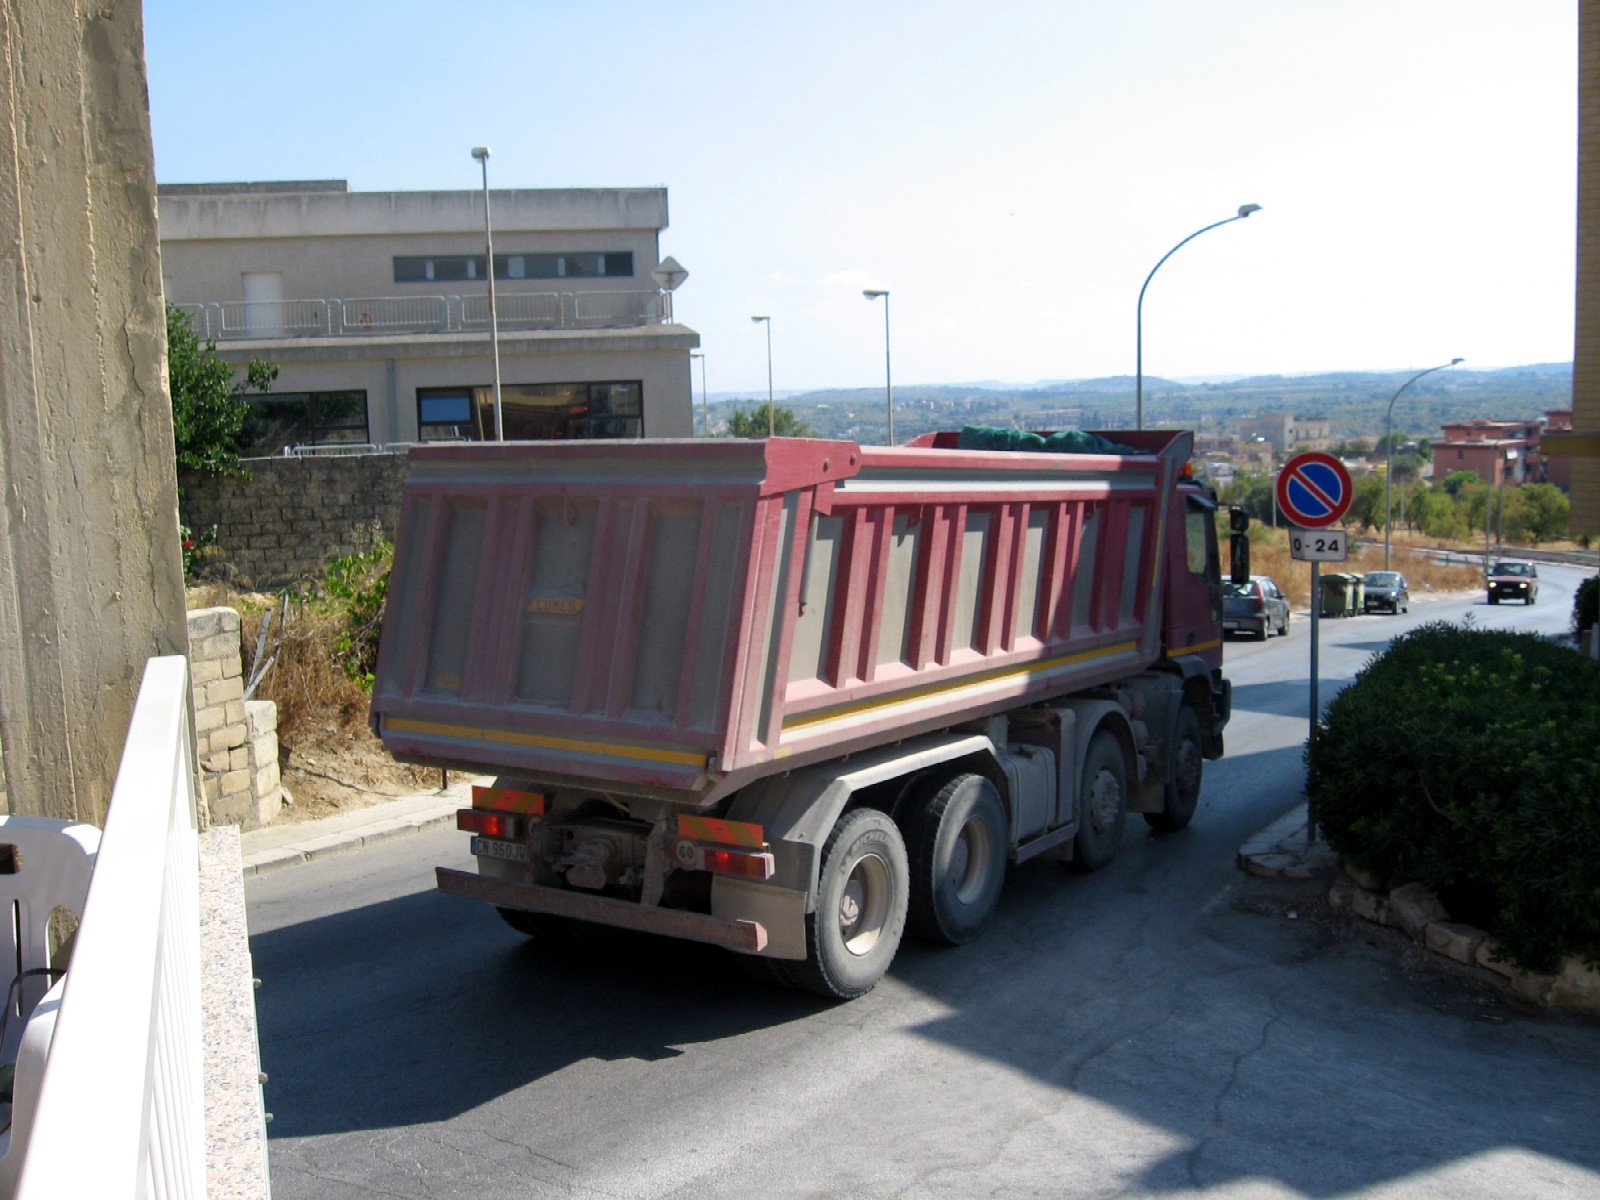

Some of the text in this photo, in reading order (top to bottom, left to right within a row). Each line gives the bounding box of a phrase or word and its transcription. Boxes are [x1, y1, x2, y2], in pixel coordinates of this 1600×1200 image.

[1294, 537, 1302, 552] 0
[1315, 538, 1339, 552] 24
[476, 839, 489, 854] CN
[851, 830, 893, 854] MICHELI
[679, 845, 694, 860] 60
